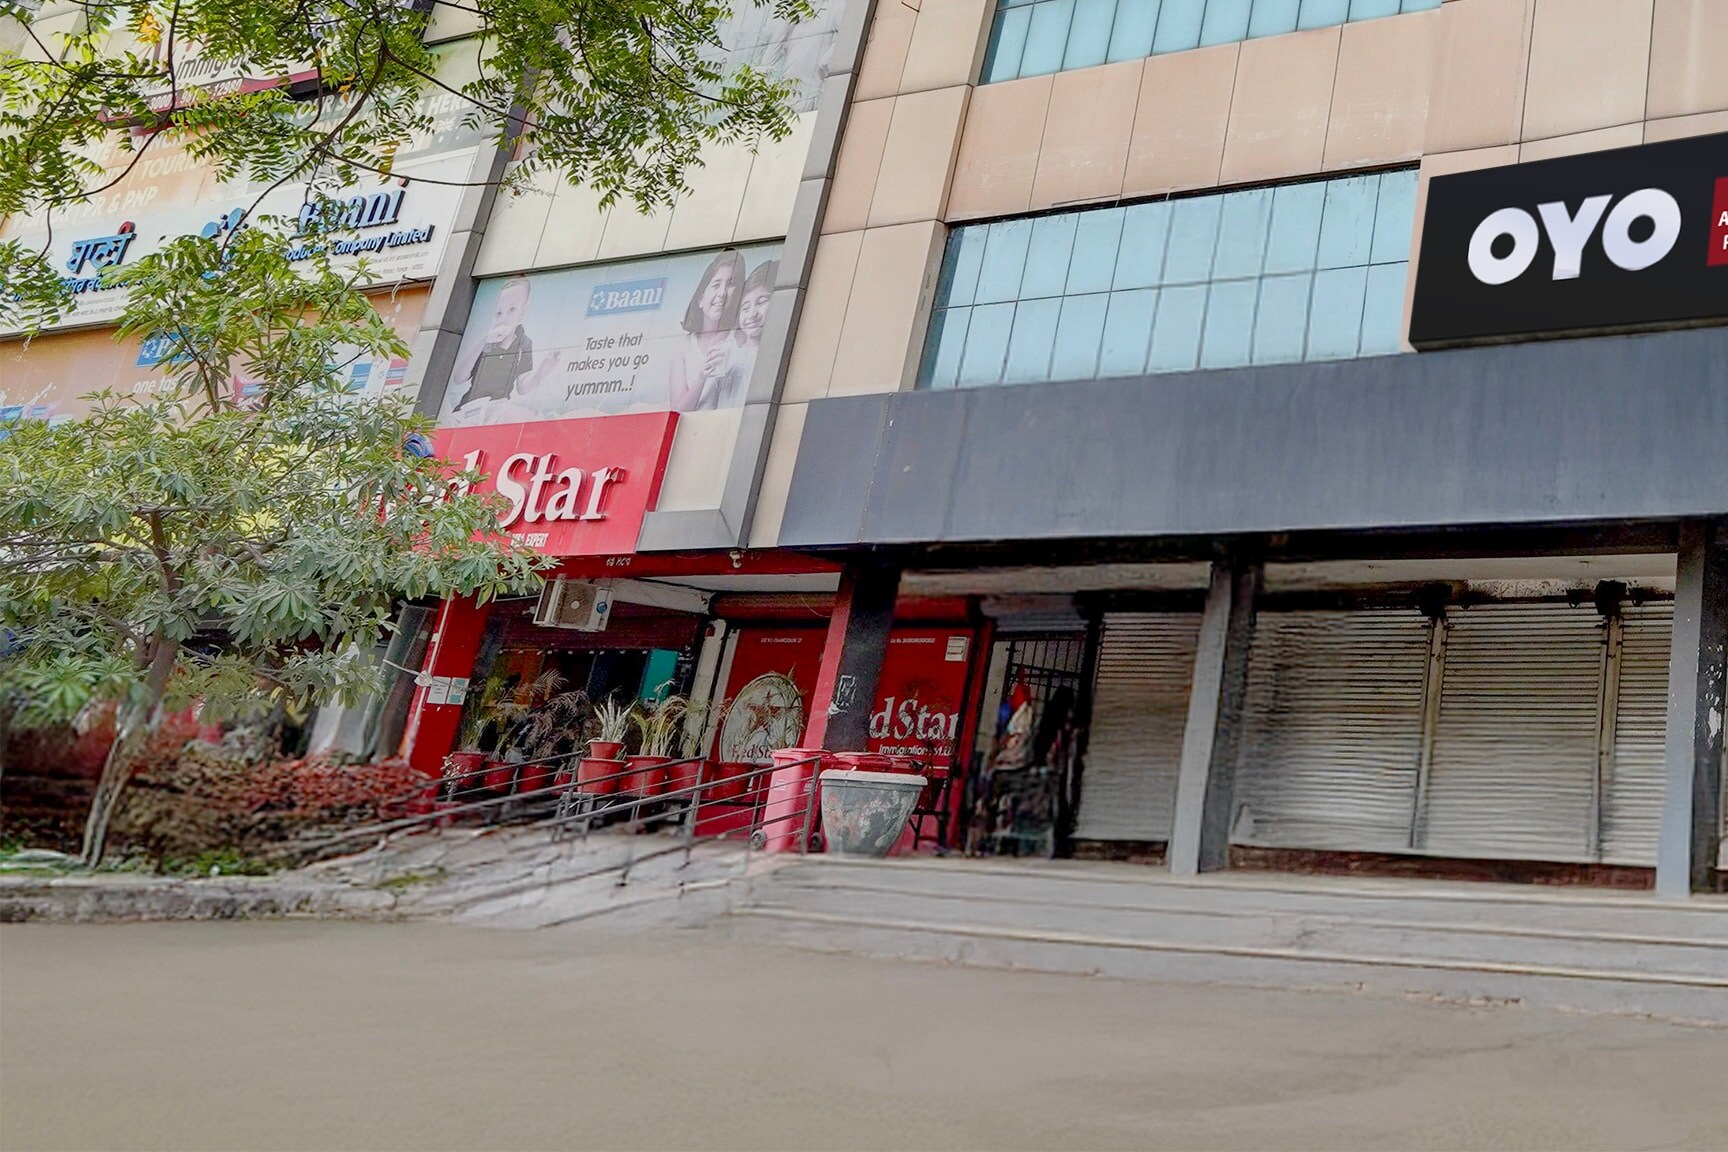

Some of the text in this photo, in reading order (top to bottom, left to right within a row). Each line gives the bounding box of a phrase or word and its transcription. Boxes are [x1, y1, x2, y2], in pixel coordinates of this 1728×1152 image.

[385, 224, 435, 247] Limited
[1467, 188, 1682, 286] OYO
[604, 278, 666, 310] Baani
[586, 332, 644, 351] Taste that
[567, 354, 650, 372] makes you go
[565, 374, 636, 402] yummm..!
[495, 449, 627, 529] Star
